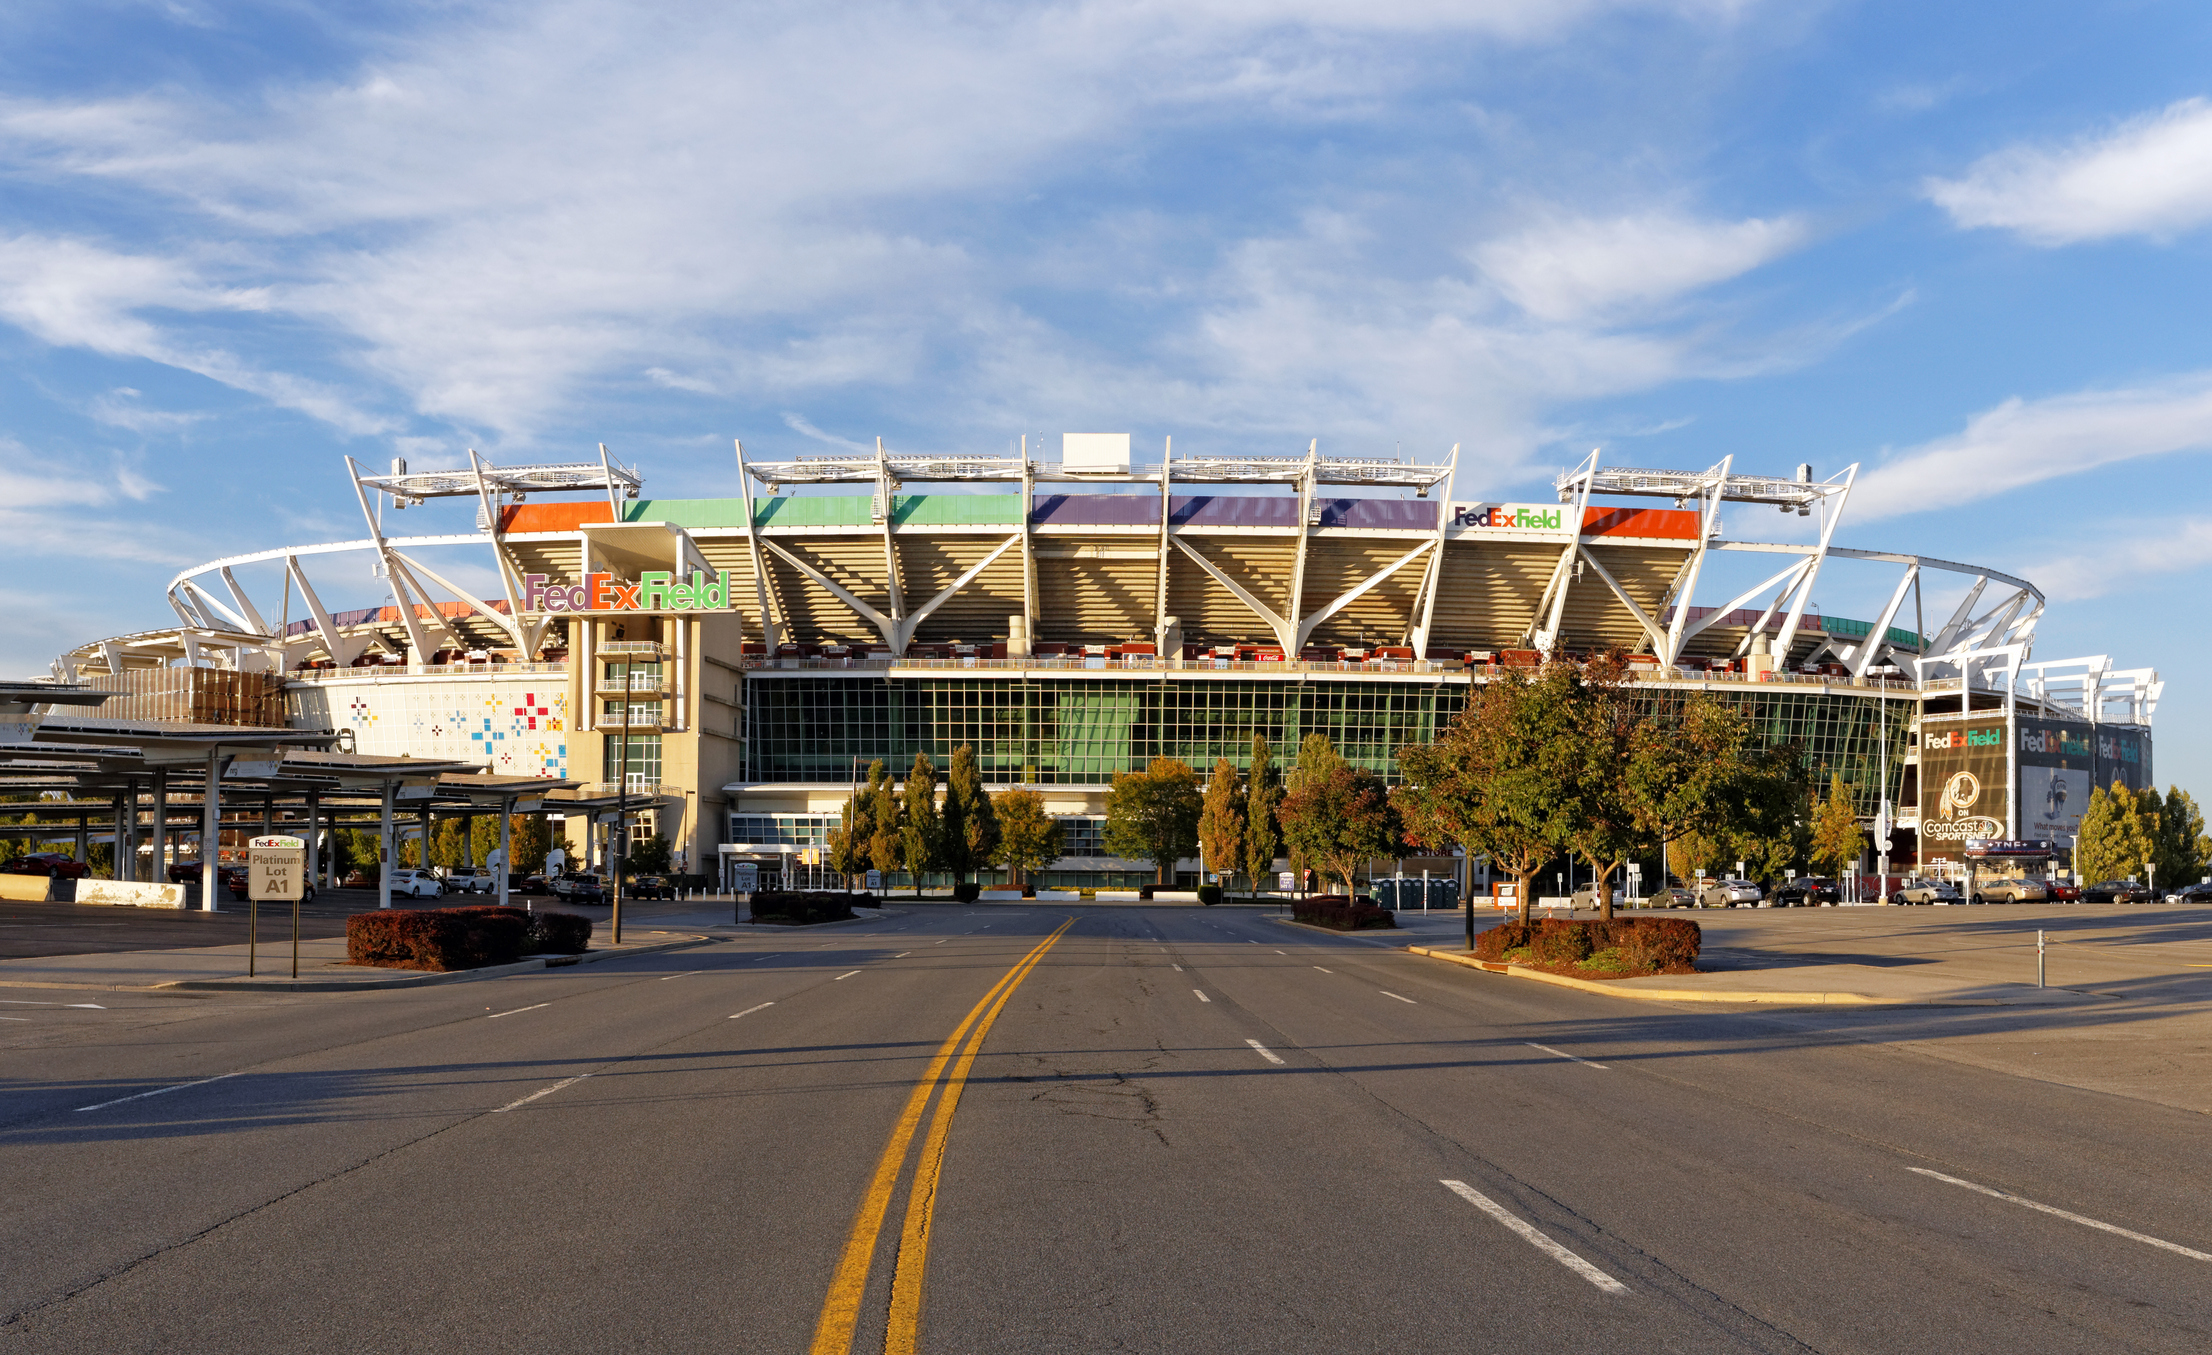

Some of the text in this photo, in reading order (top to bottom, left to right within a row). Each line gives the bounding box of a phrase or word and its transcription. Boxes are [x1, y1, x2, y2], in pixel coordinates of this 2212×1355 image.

[1454, 506, 1561, 529] FedExField
[525, 570, 730, 612] FedExField
[1925, 728, 2001, 749] FedExField
[2099, 735, 2139, 764] FedExField
[2033, 822, 2079, 833] What moves you?
[1936, 831, 1993, 841] SPORTSNET
[255, 839, 299, 848] FedExField
[1422, 849, 1454, 857] STORE
[252, 854, 300, 865] Platinum
[265, 866, 287, 876] Lot
[265, 879, 288, 893] A1
